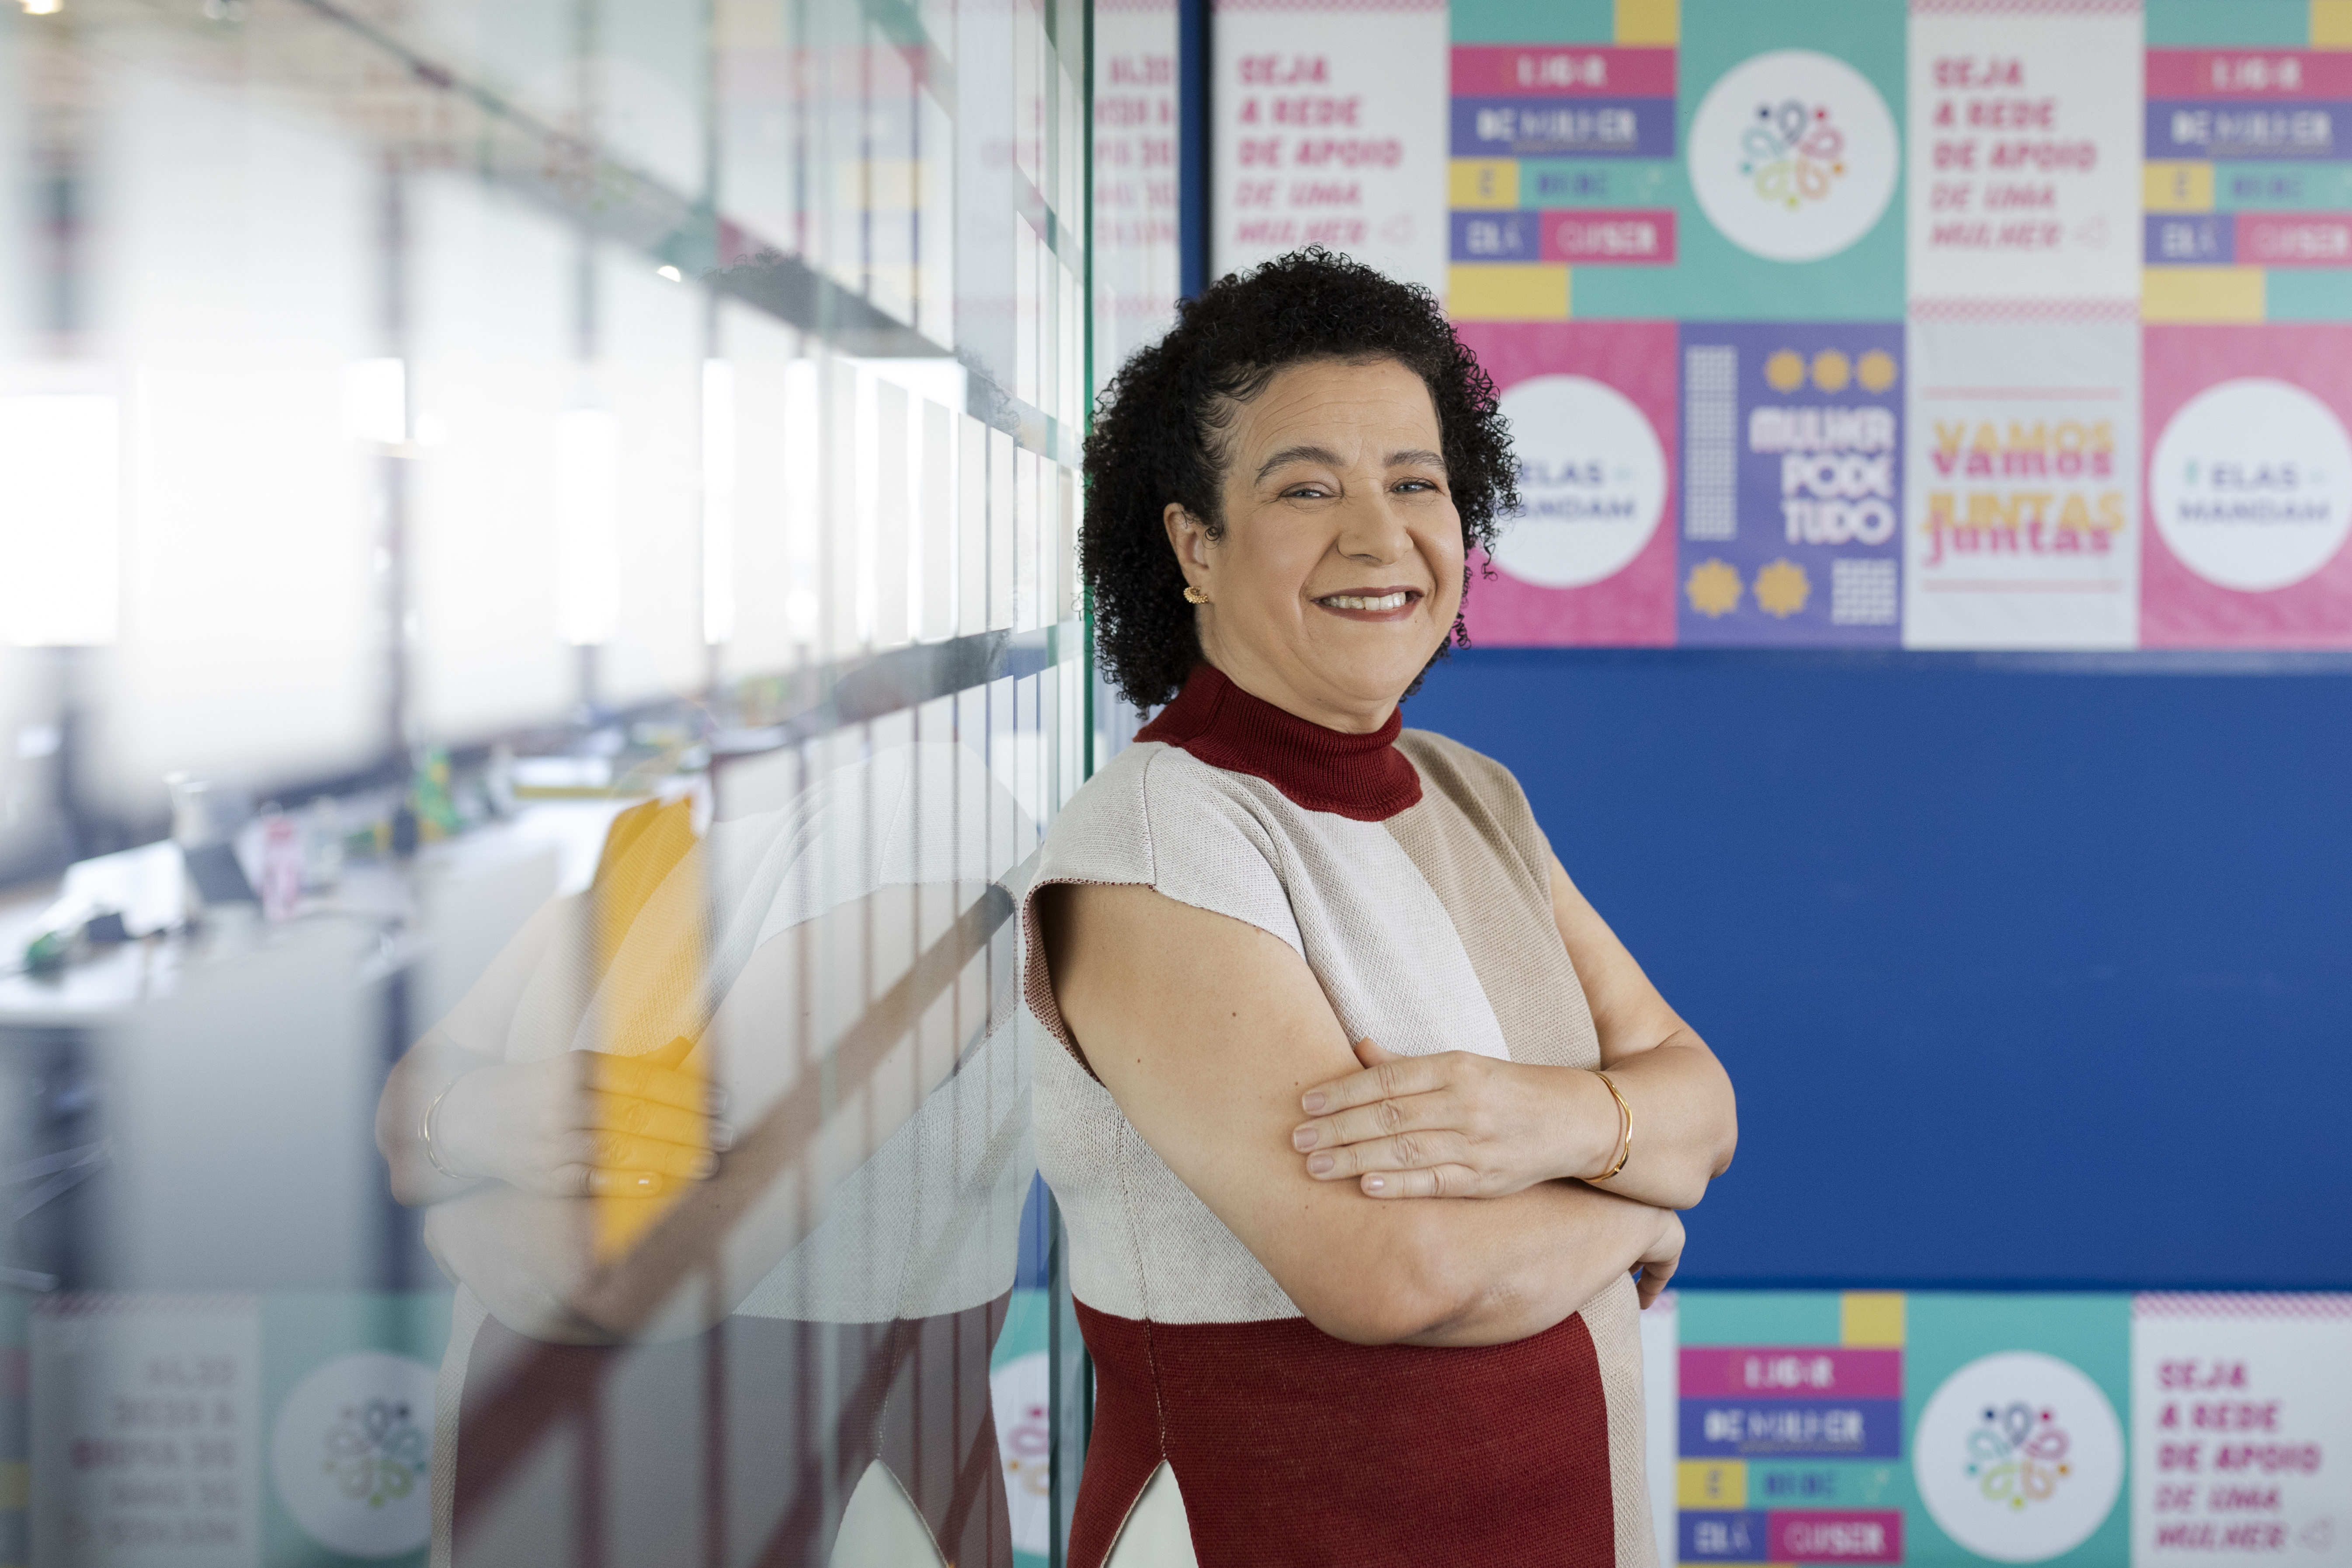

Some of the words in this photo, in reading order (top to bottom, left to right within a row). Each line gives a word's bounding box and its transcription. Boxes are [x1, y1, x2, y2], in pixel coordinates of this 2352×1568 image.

[1238, 55, 1328, 86] SEJA
[1934, 57, 2025, 88] SEJA
[1239, 96, 1261, 124] A
[1934, 98, 1956, 127] A
[1750, 405, 1895, 453] MULHER
[1932, 420, 2115, 457] VAMOS
[1782, 455, 1895, 501] PODE
[1931, 446, 2114, 479] vamos
[1781, 499, 1897, 545] TUDO
[1923, 490, 2125, 533] JUNTAS
[1922, 511, 2113, 567] juntas
[2157, 1359, 2249, 1392] SEJA
[2157, 1401, 2181, 1429] A
